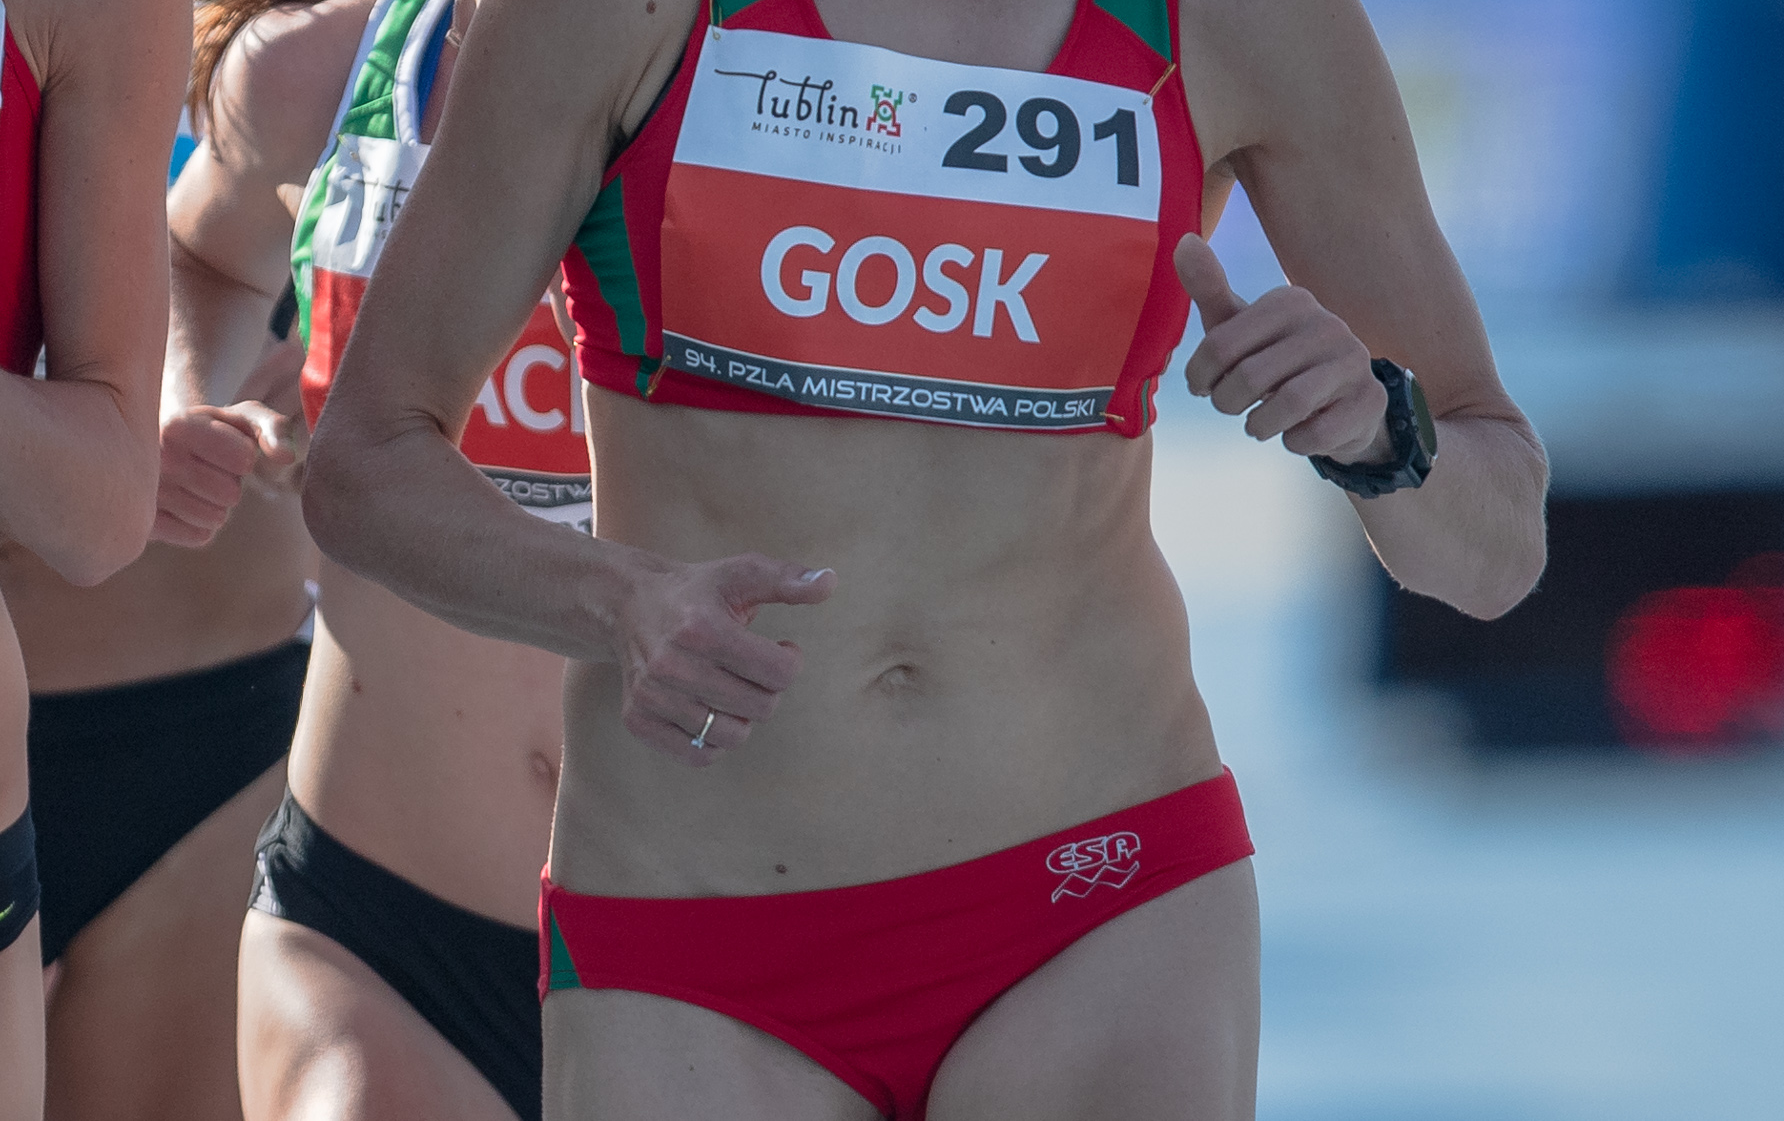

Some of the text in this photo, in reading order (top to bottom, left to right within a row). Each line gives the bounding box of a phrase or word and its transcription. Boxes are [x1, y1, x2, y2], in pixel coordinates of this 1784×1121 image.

[751, 121, 902, 155] MIASTO INSPIRACJI
[941, 90, 1139, 187] 291
[760, 225, 1049, 344] GOSK
[684, 348, 1096, 419] 94. PZLA MISTRZOSTWA POLSKI
